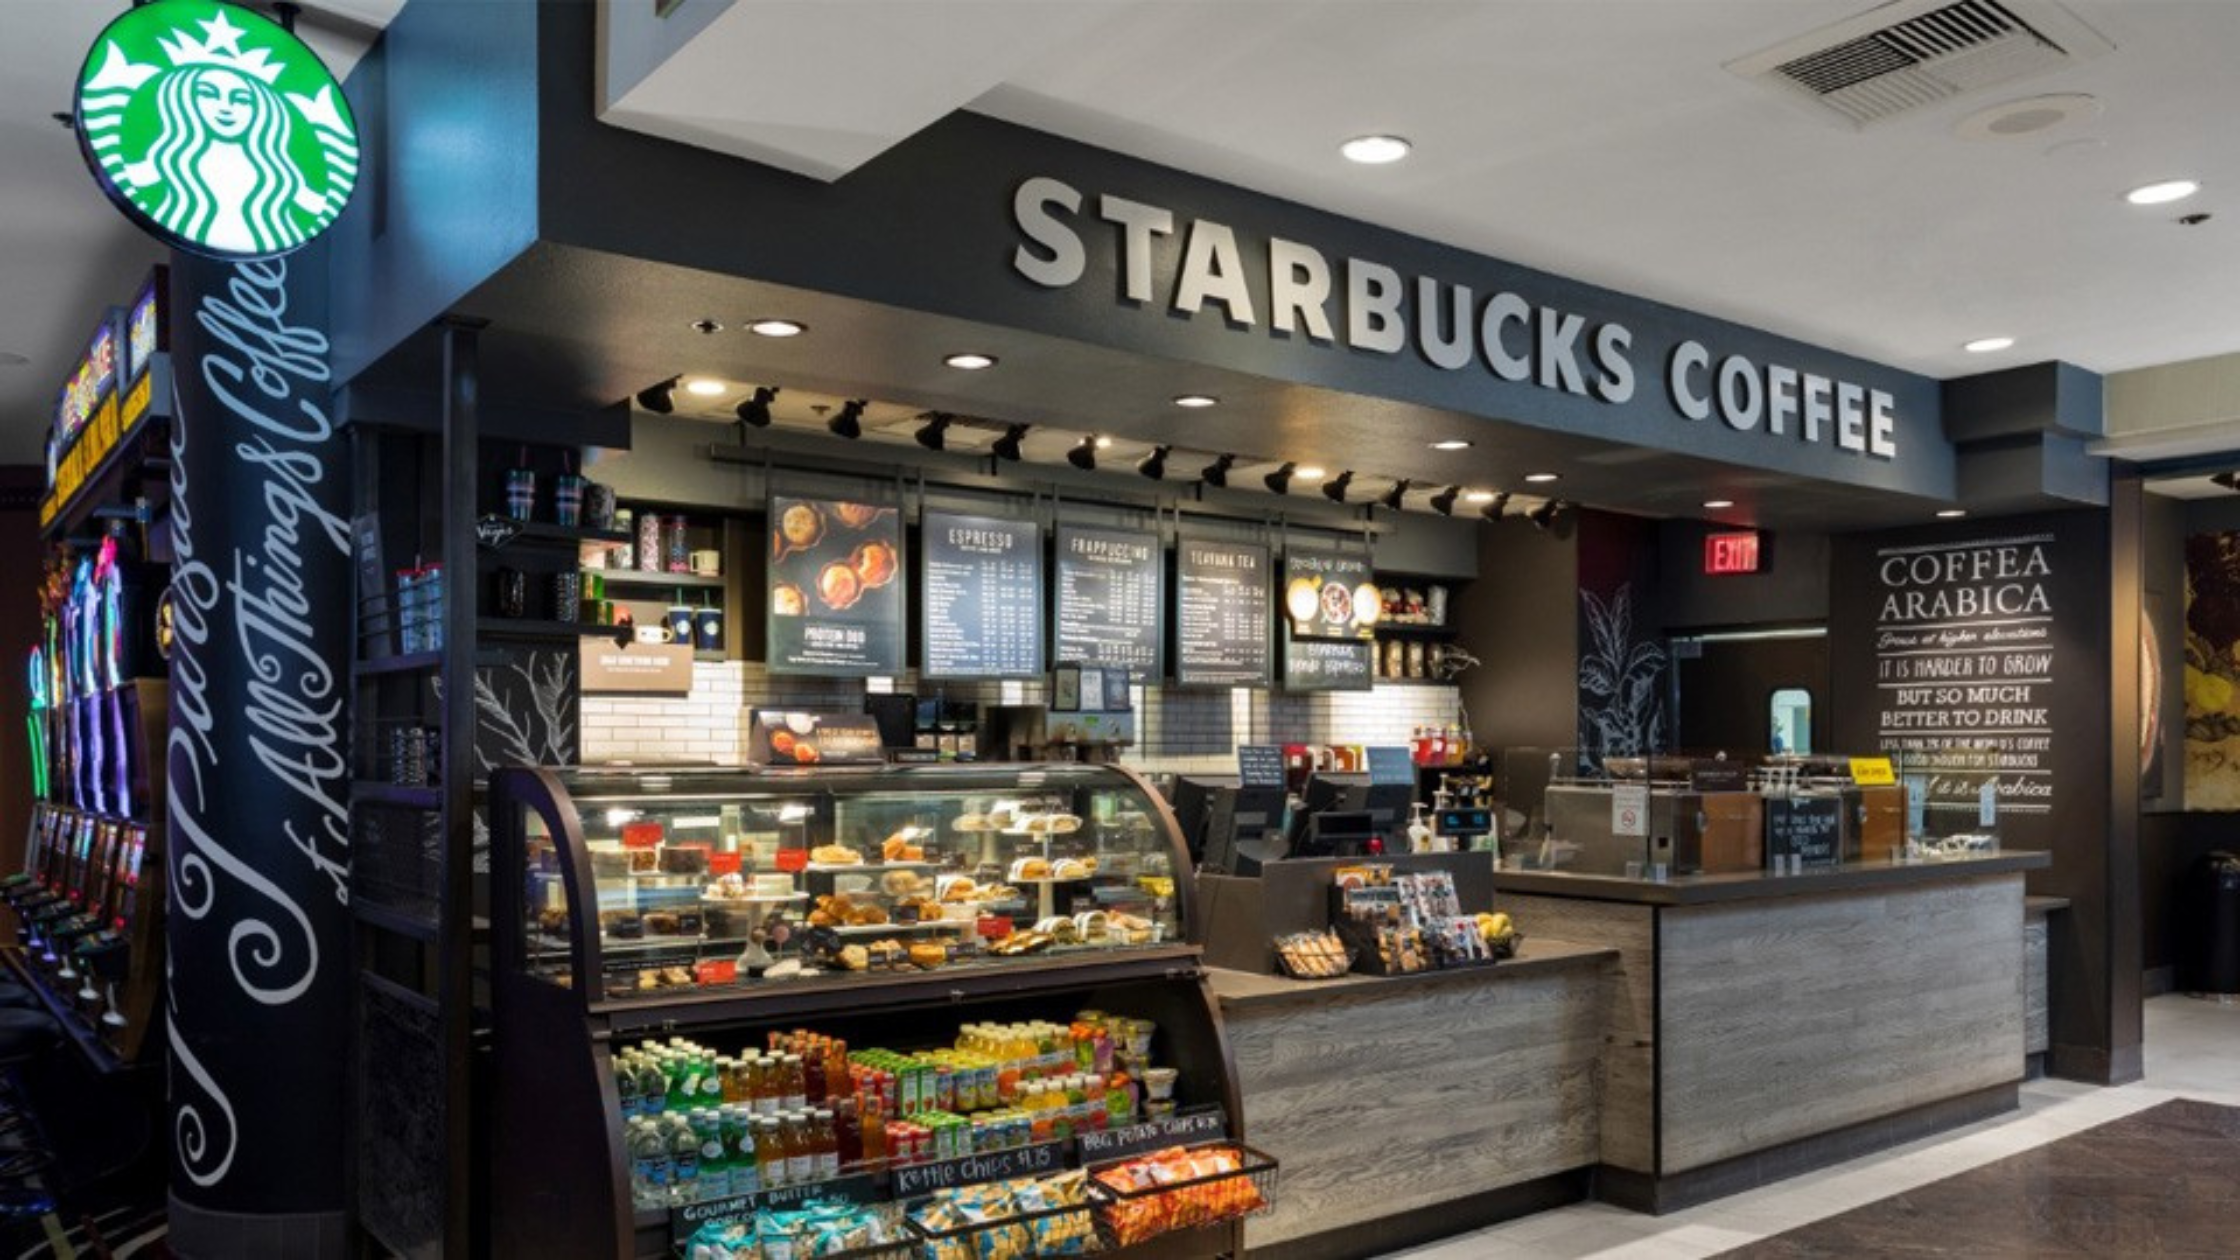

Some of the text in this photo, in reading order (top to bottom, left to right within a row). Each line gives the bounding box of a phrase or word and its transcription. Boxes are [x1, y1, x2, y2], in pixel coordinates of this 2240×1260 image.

[1013, 177, 1898, 460] STARBUCKS COFFEE
[195, 257, 331, 443] Coffee
[948, 527, 1013, 549] ESPRESSO
[1071, 537, 1149, 561] FRAPPUCCINO
[226, 434, 350, 699] Things
[1191, 549, 1256, 569] TEAVANA TEA
[1714, 537, 1757, 571] EXIT
[1879, 545, 2052, 587] COFFEA
[1878, 583, 2052, 621] ARABICA
[1939, 629, 1978, 648] higher
[1983, 627, 2048, 641] elevations
[1879, 653, 2053, 679] IT IS HARDER TO GROW
[1897, 685, 2031, 706] BUT SO MUCH
[1881, 709, 2048, 727] BETTER TO DRINK
[244, 680, 348, 846] All
[898, 1162, 955, 1193] Kettle
[960, 1154, 1012, 1180] Chips
[683, 1194, 757, 1221] GOURMET
